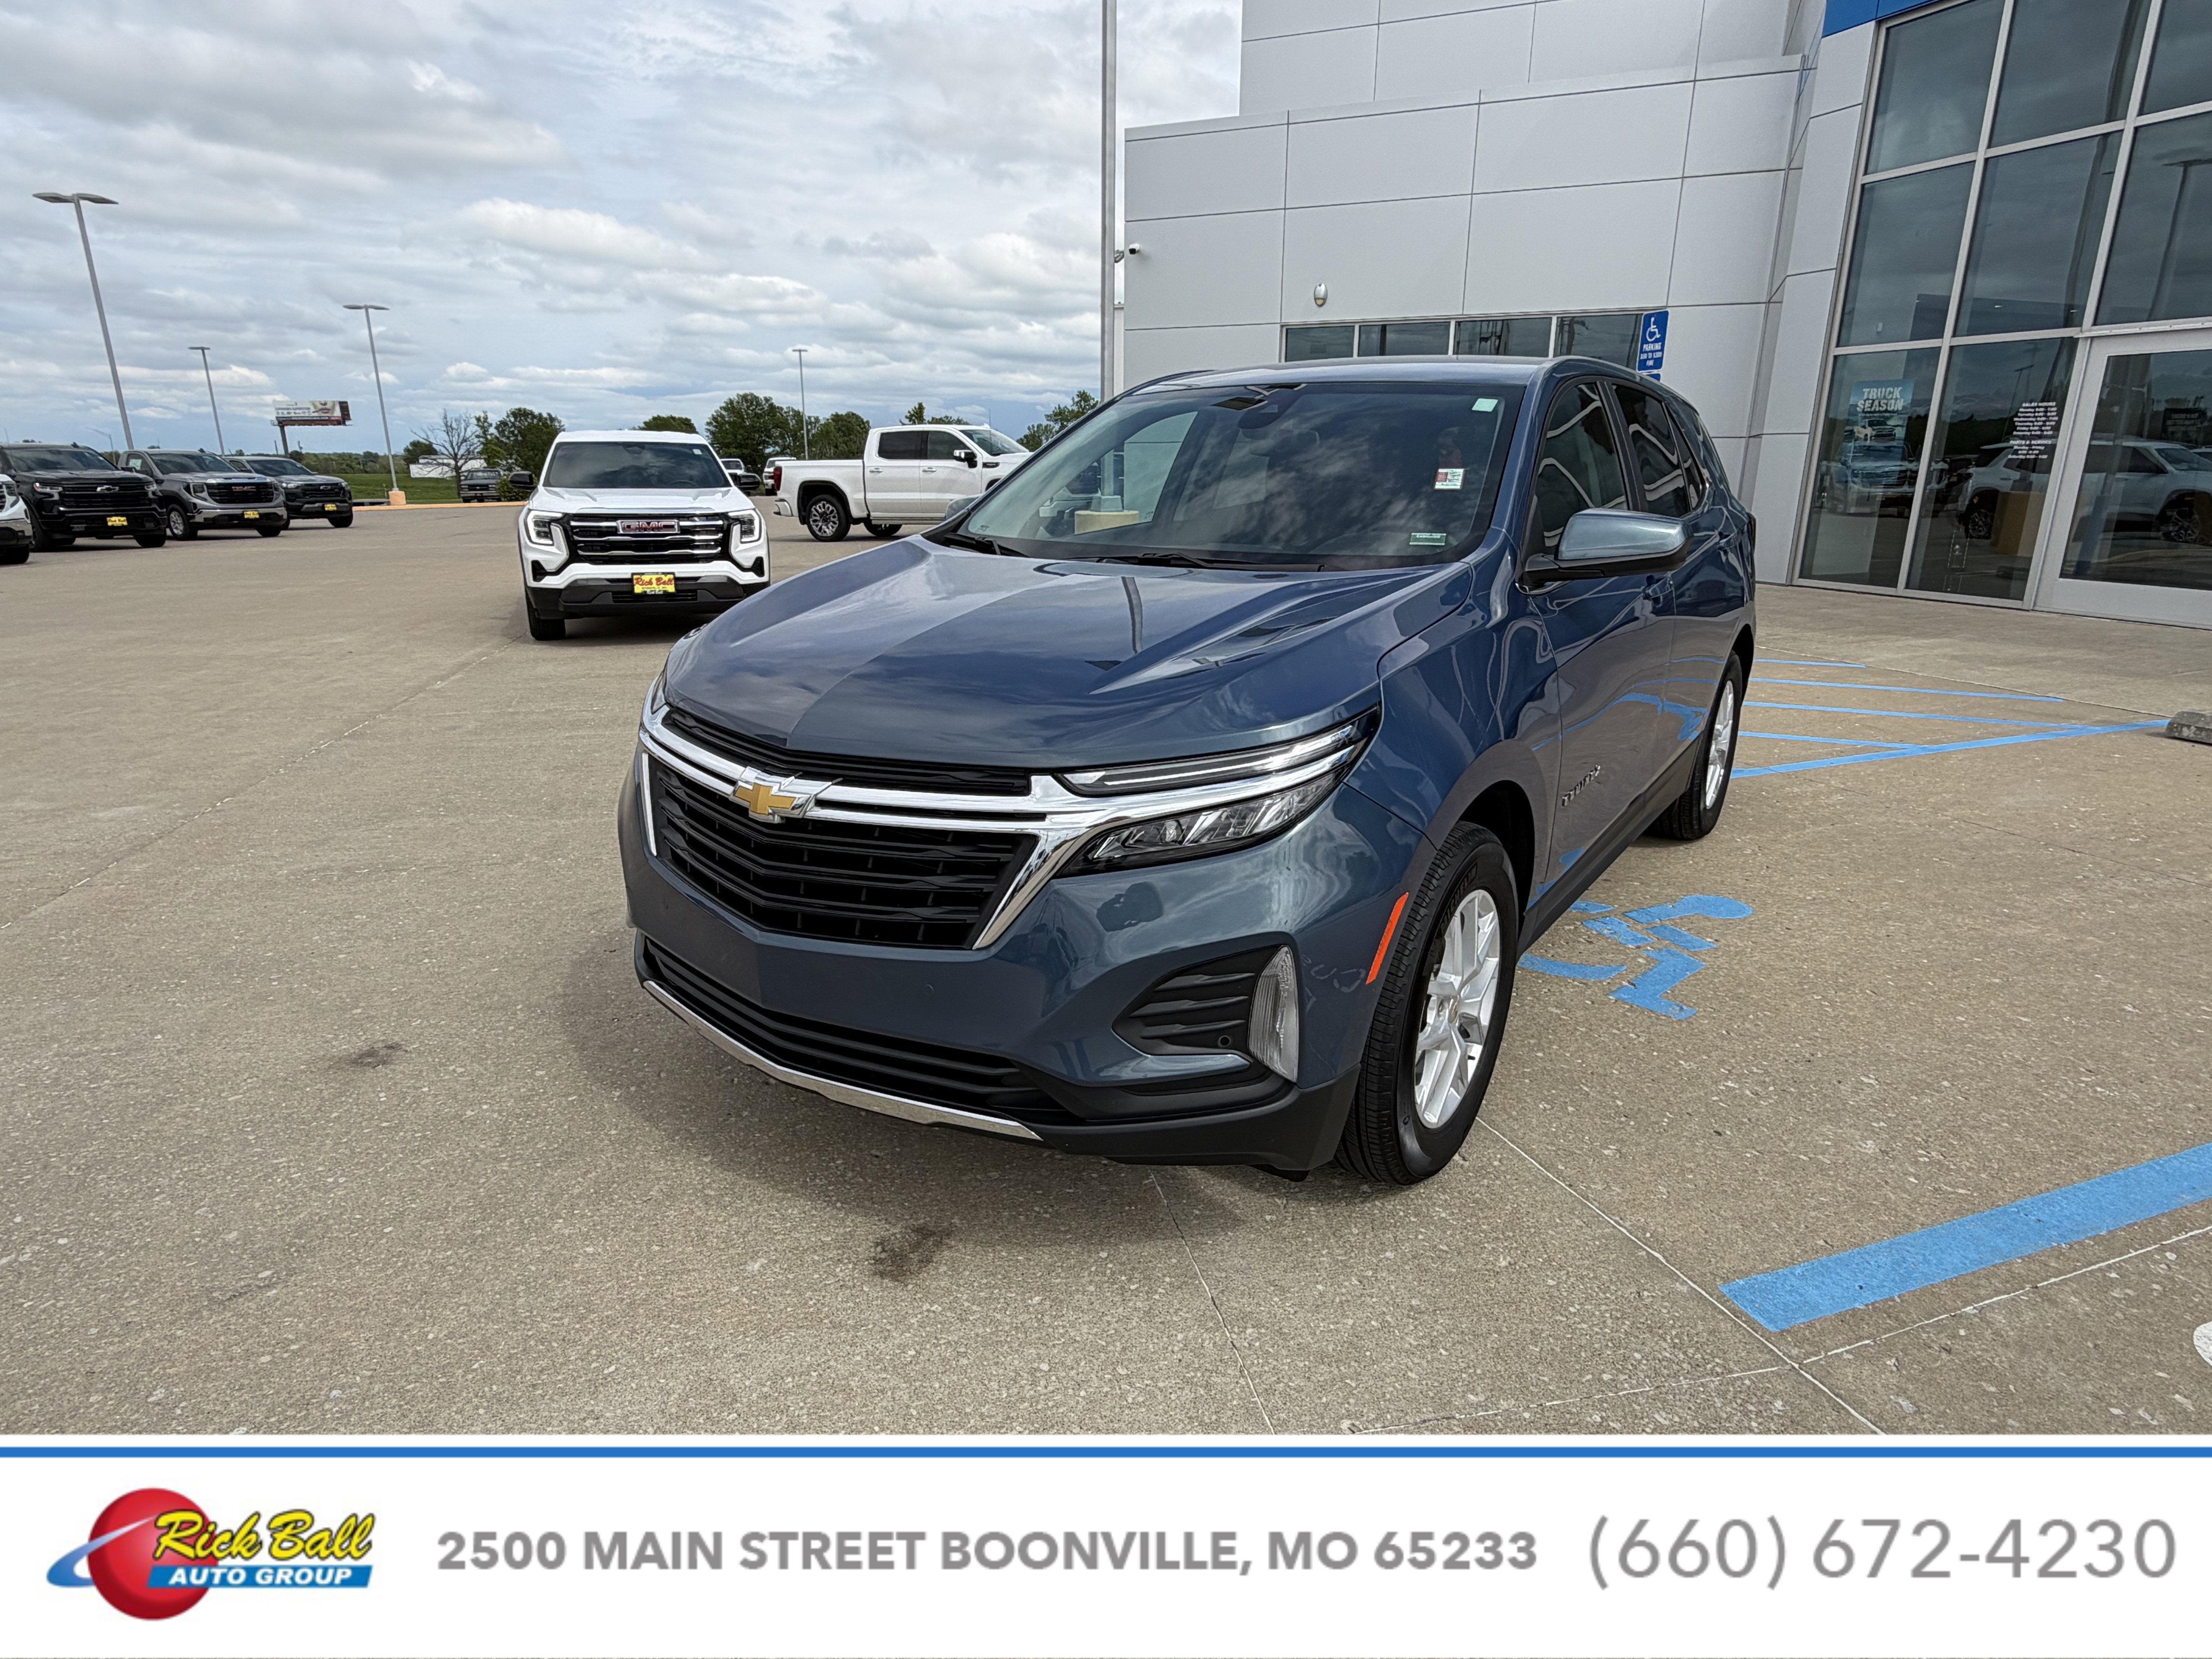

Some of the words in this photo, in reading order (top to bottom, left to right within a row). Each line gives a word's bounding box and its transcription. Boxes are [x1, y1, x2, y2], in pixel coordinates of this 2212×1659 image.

[1863, 387, 1902, 399] TRUCK
[1856, 399, 1904, 412] SEASON
[622, 521, 675, 532] GMC
